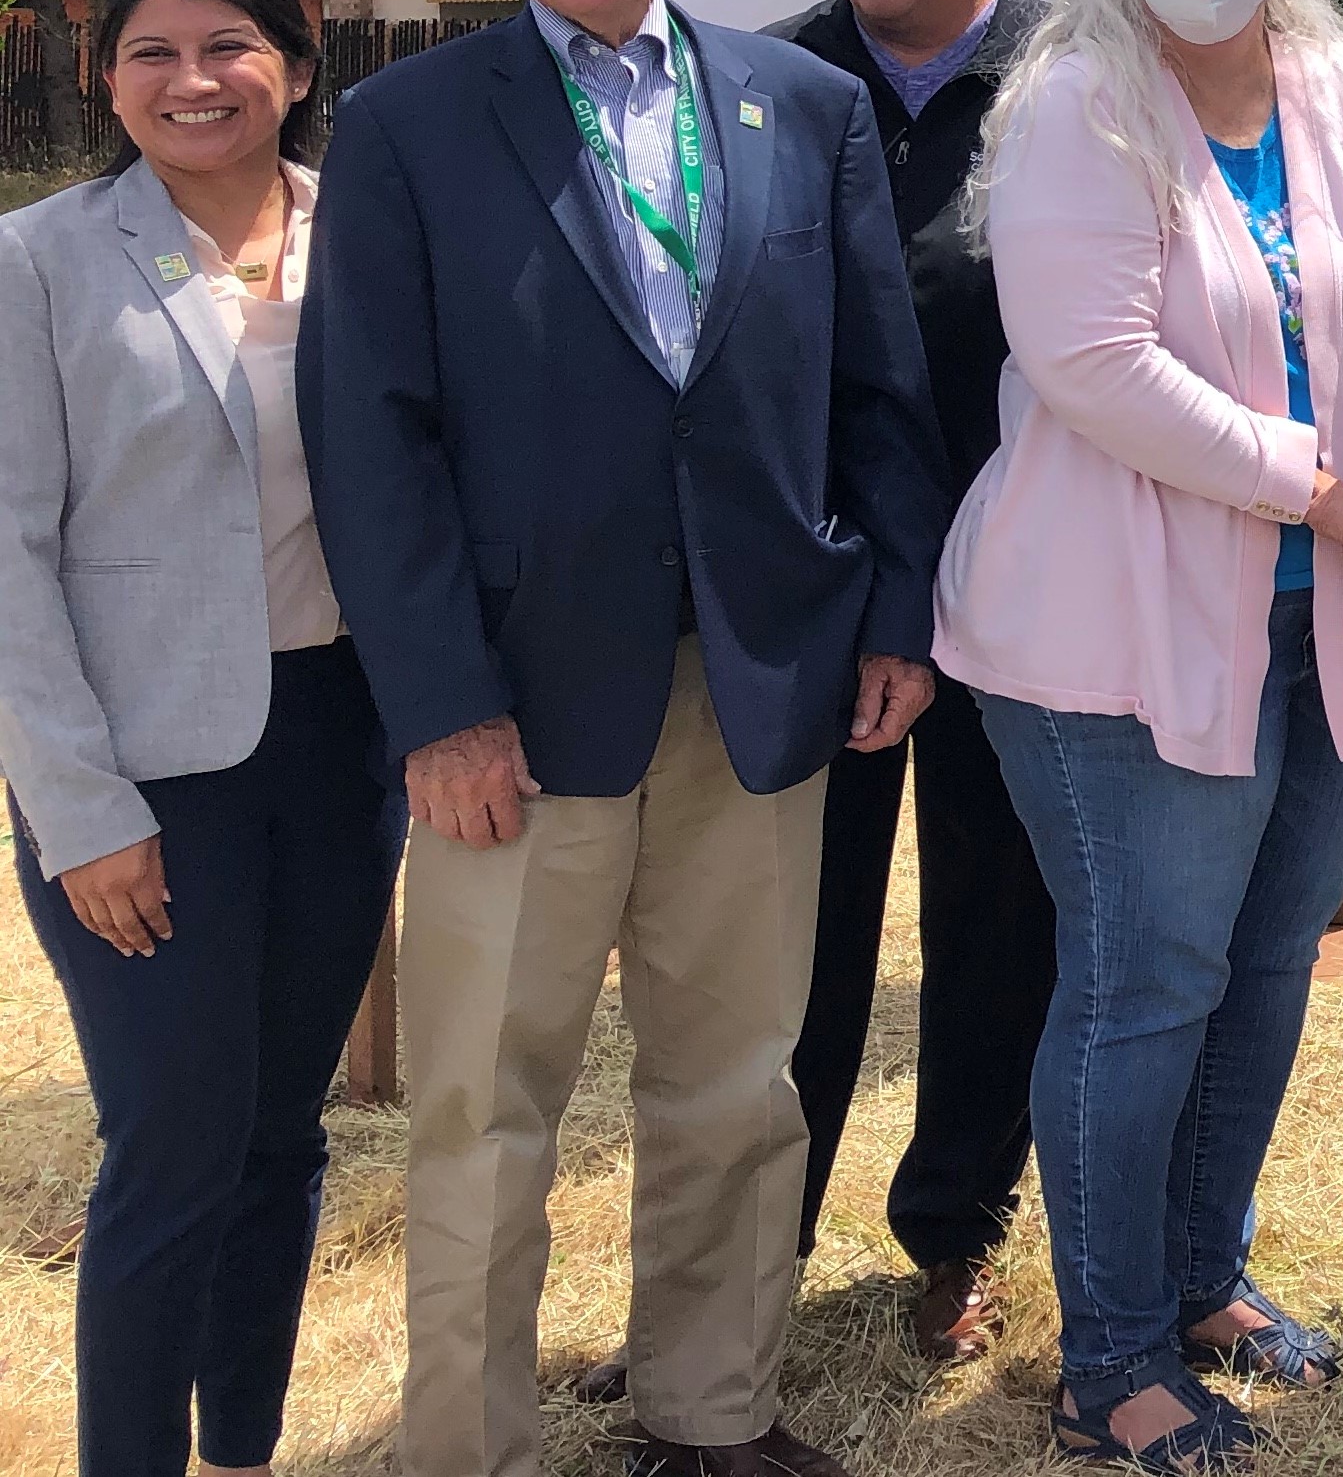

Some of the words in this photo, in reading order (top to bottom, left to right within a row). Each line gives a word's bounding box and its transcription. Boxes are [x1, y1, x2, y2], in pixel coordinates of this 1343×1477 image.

[575, 99, 598, 132] CITY
[589, 134, 606, 154] OF
[681, 112, 695, 134] OF
[682, 135, 699, 168] CITY
